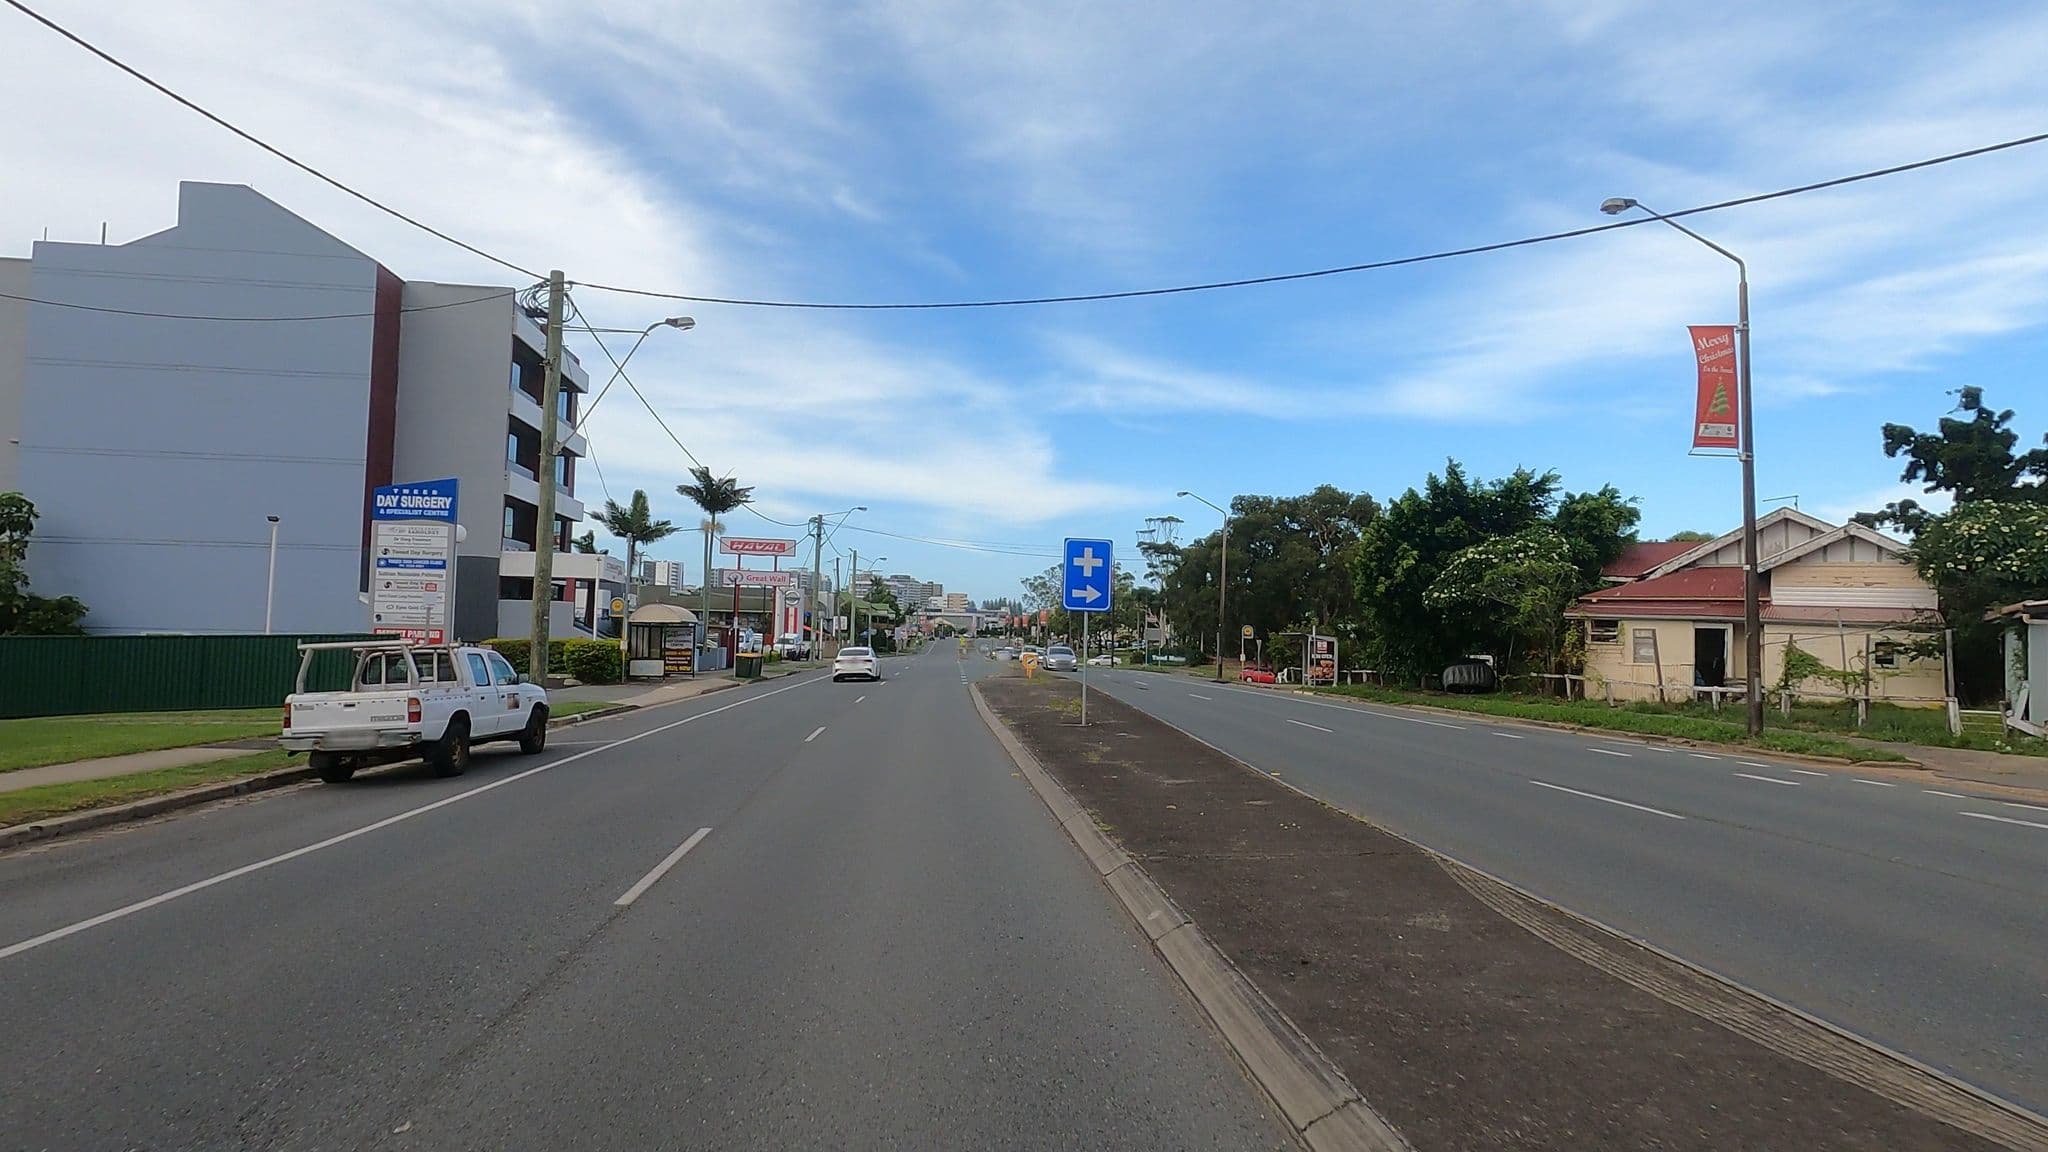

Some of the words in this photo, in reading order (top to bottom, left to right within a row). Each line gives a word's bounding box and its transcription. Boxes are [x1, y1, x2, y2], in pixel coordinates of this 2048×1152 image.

[1697, 334, 1729, 350] Merry
[1699, 347, 1734, 364] Christmas
[376, 494, 399, 508] DAY
[400, 495, 453, 509] SURGERY
[386, 508, 422, 516] SPECIALIST
[423, 509, 449, 517] CENTRE
[731, 541, 784, 552] HAVAL
[746, 574, 767, 582] Great
[769, 575, 786, 583] Wall
